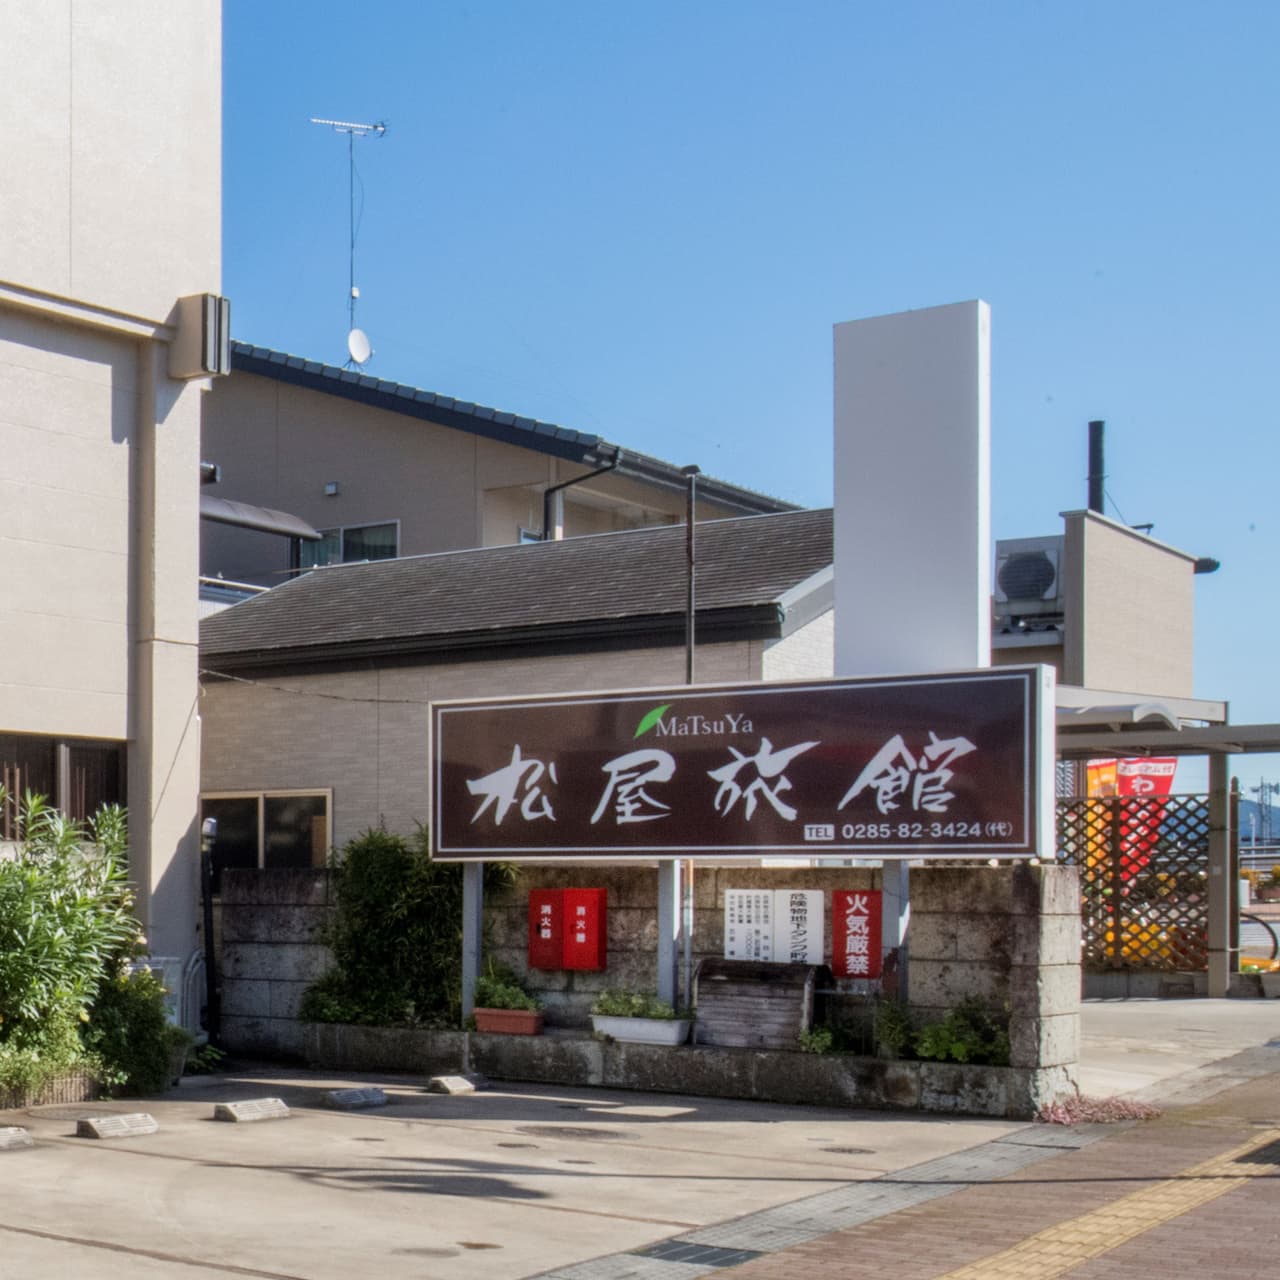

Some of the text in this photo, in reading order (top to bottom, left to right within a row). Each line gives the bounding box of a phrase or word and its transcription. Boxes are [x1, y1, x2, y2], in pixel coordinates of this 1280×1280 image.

[655, 712, 754, 737] MaTsuYa
[466, 731, 977, 825] 松屋旅館
[806, 825, 834, 839] TEL
[846, 894, 869, 974] 火気厳禁
